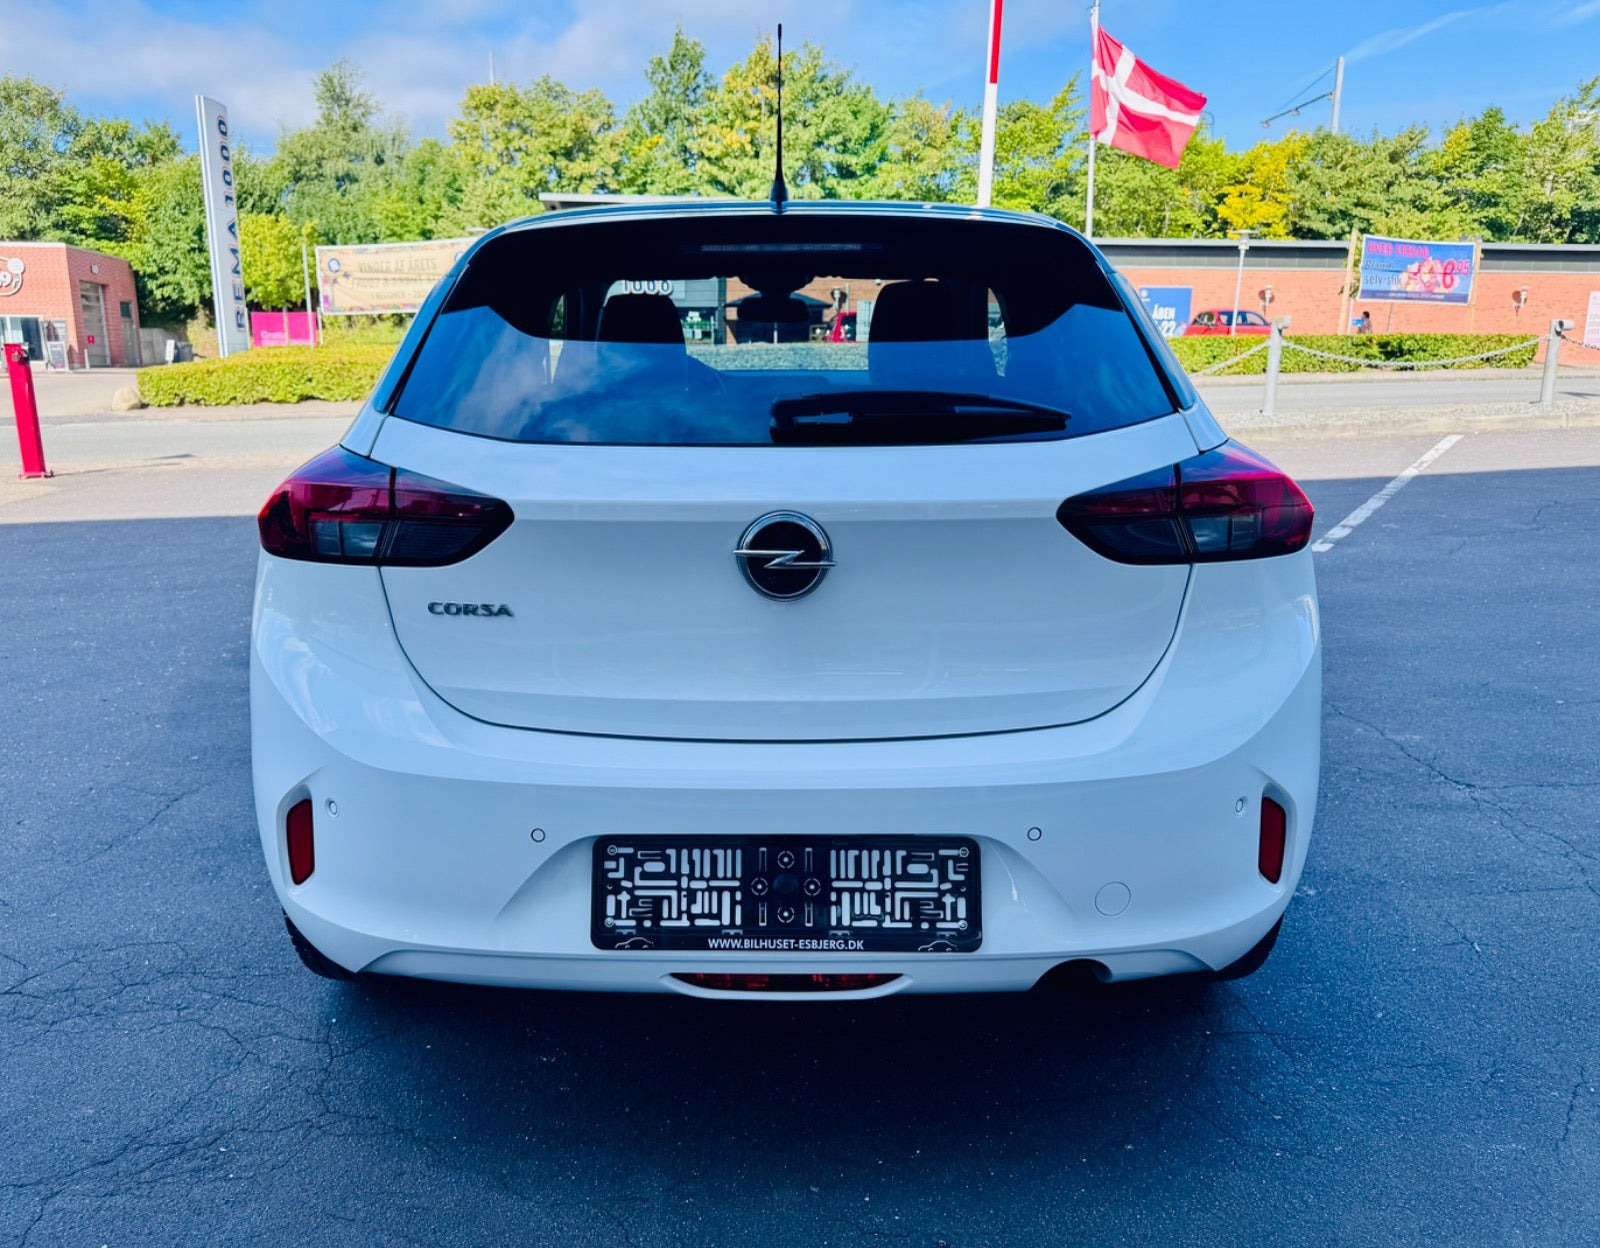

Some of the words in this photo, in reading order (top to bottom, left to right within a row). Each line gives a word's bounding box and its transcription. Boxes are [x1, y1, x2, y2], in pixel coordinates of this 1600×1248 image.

[217, 115, 234, 208] 1000
[1367, 241, 1393, 256] HVER
[357, 261, 392, 273] VINDER
[408, 255, 438, 272] ÅRETS
[227, 218, 246, 331] REMA
[1152, 303, 1176, 320] ÅBEN
[427, 601, 515, 618] CORSA
[707, 938, 865, 950] WWW.BILHUSET-ESBJERG.DK
